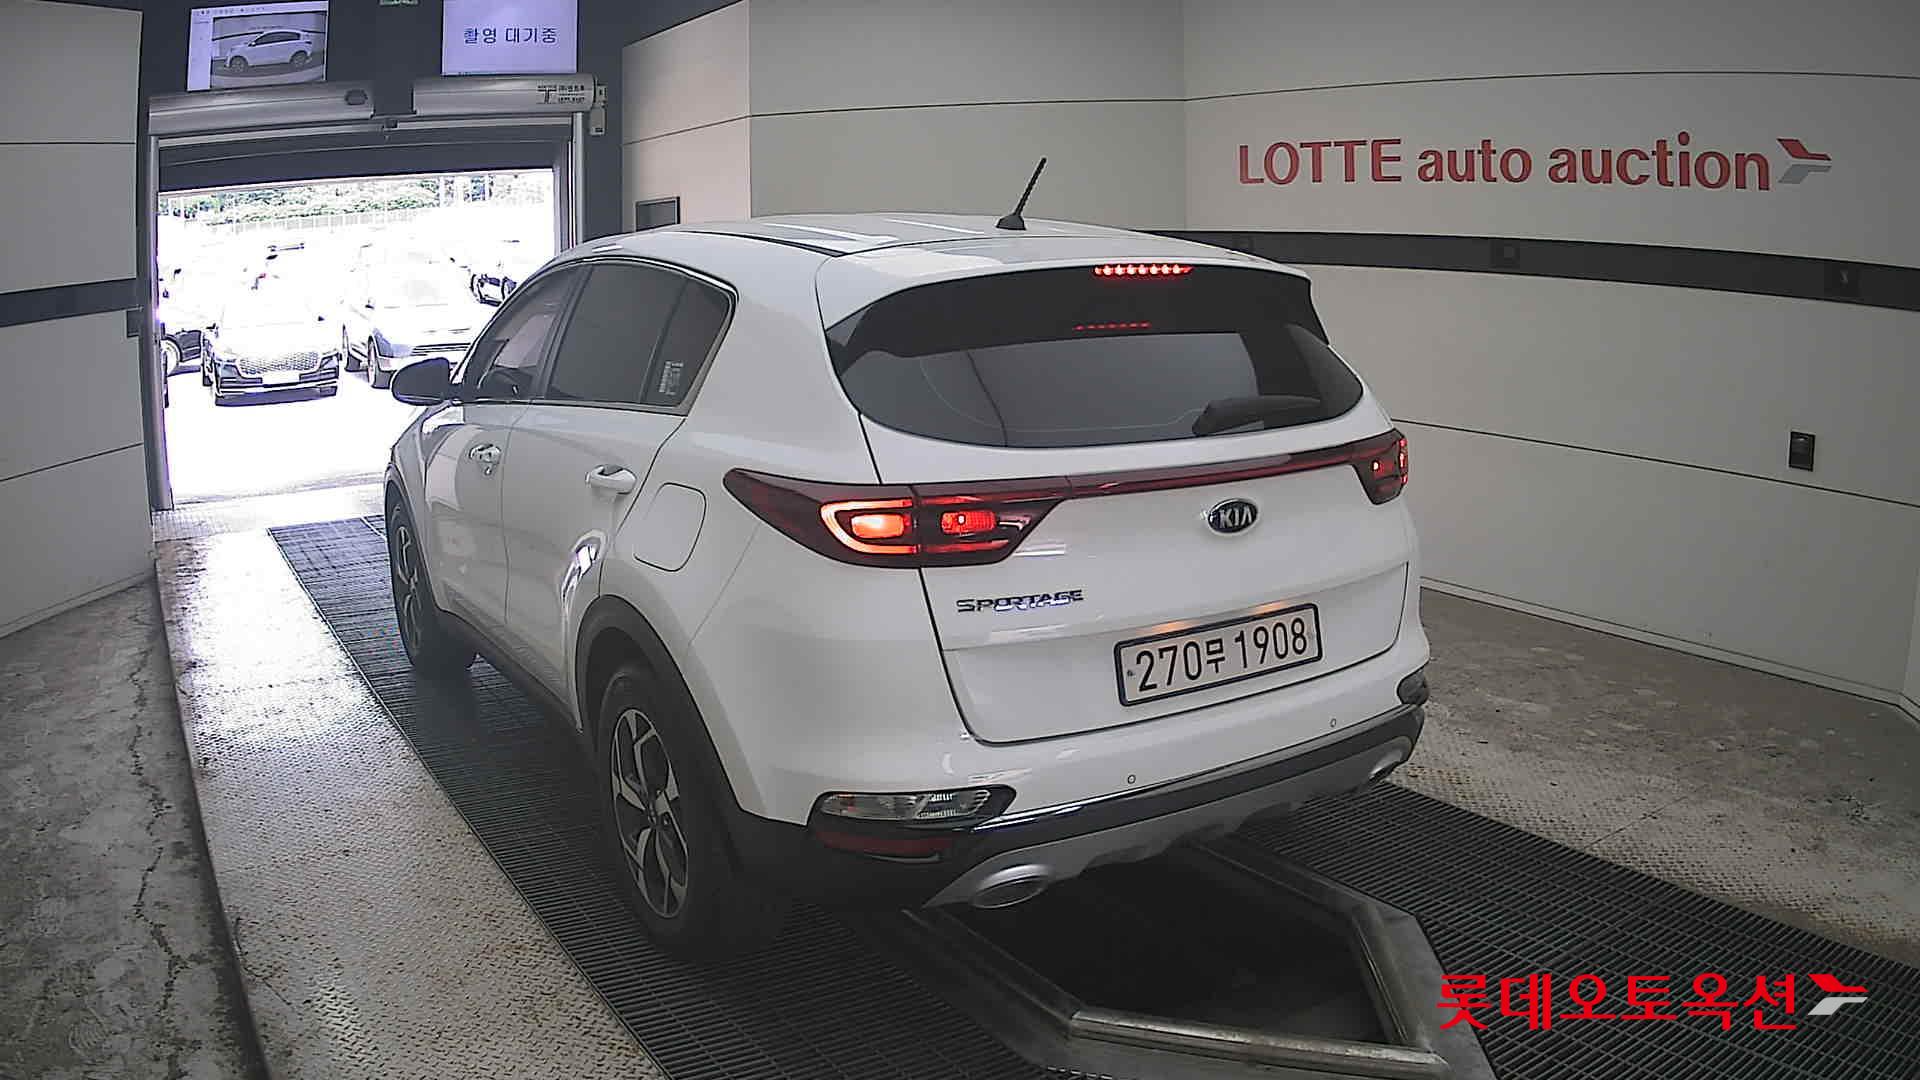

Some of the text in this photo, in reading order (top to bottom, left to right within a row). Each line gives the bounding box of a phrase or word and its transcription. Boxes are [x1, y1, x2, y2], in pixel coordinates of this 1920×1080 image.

[464, 27, 557, 44] 촬영 대기중
[1238, 131, 1771, 191] LOTTE auto auction
[1219, 505, 1252, 529] KIA
[956, 589, 1084, 613] SPORTAGE
